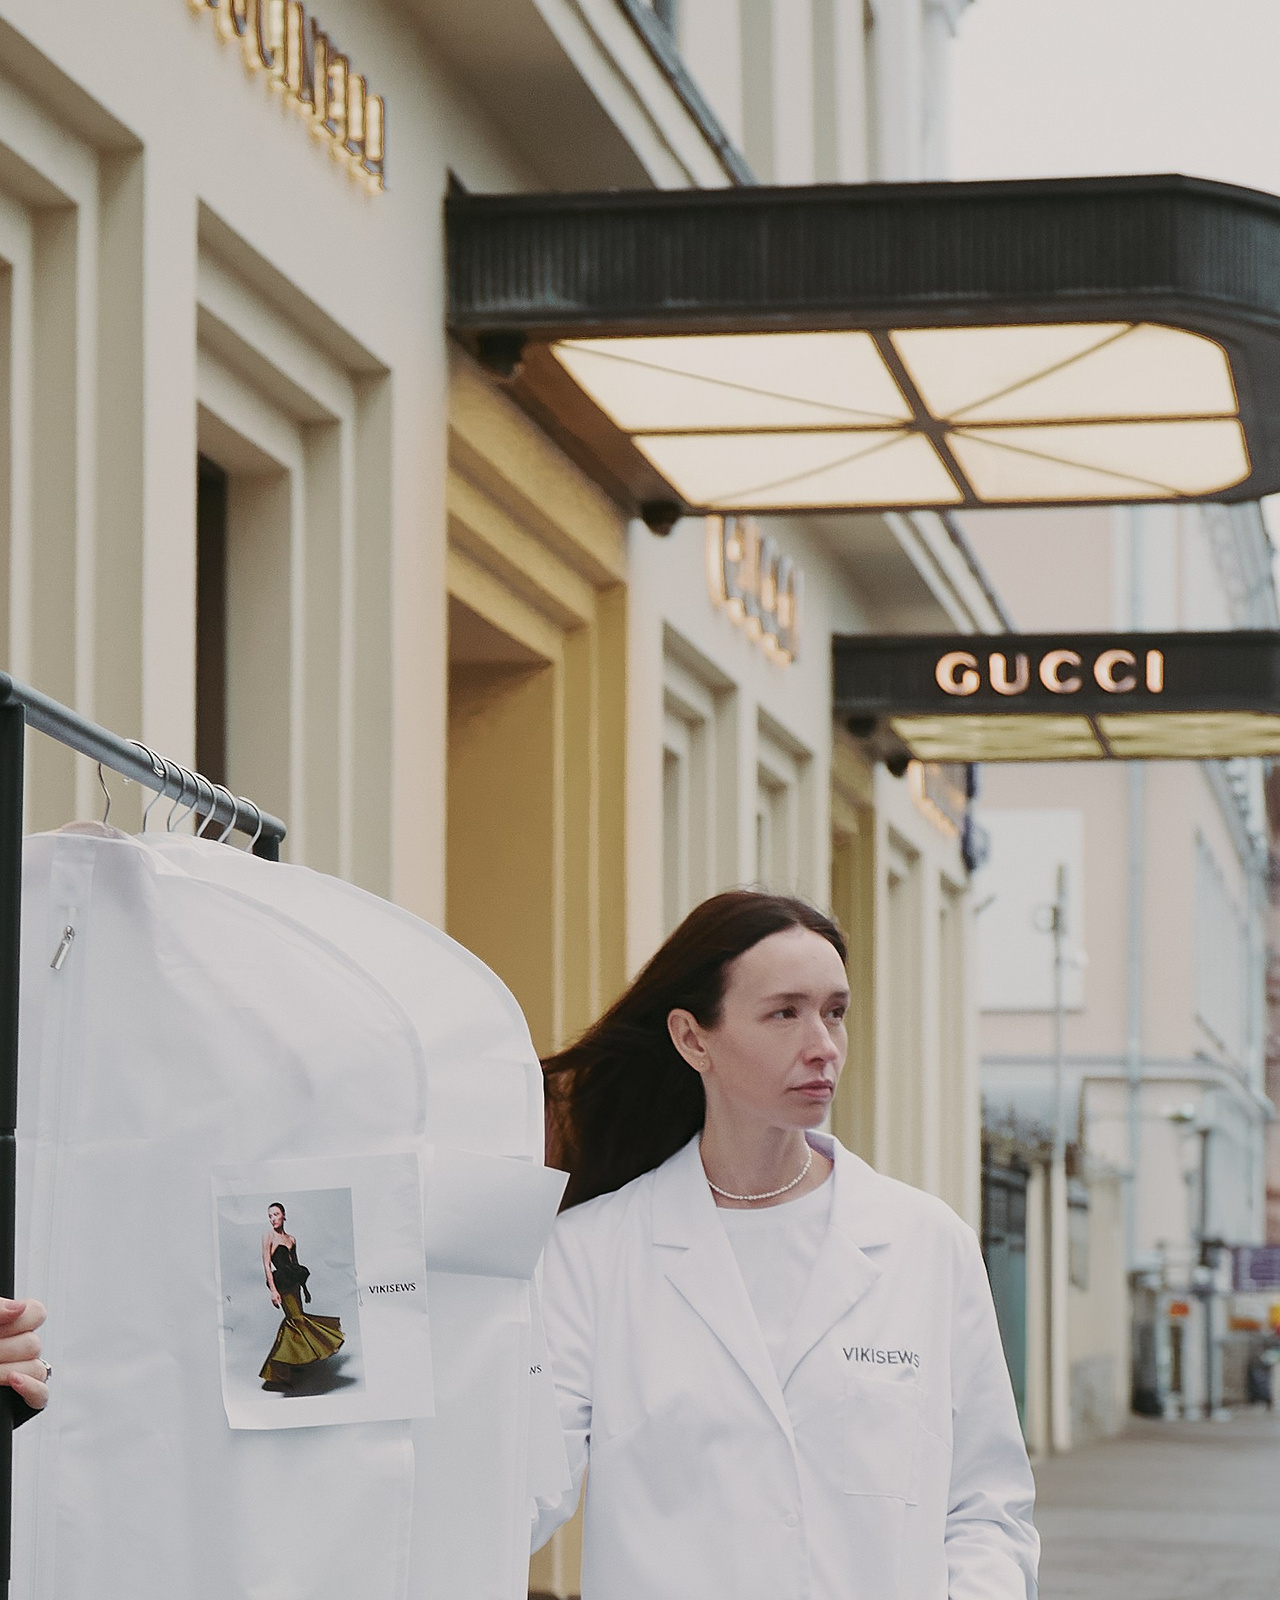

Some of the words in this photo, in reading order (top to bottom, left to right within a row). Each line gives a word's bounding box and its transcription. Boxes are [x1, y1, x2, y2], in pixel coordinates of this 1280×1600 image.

[934, 649, 1165, 697] GUCCI
[368, 1282, 417, 1295] VIKISEWS
[842, 1346, 920, 1369] VIKISEWS
